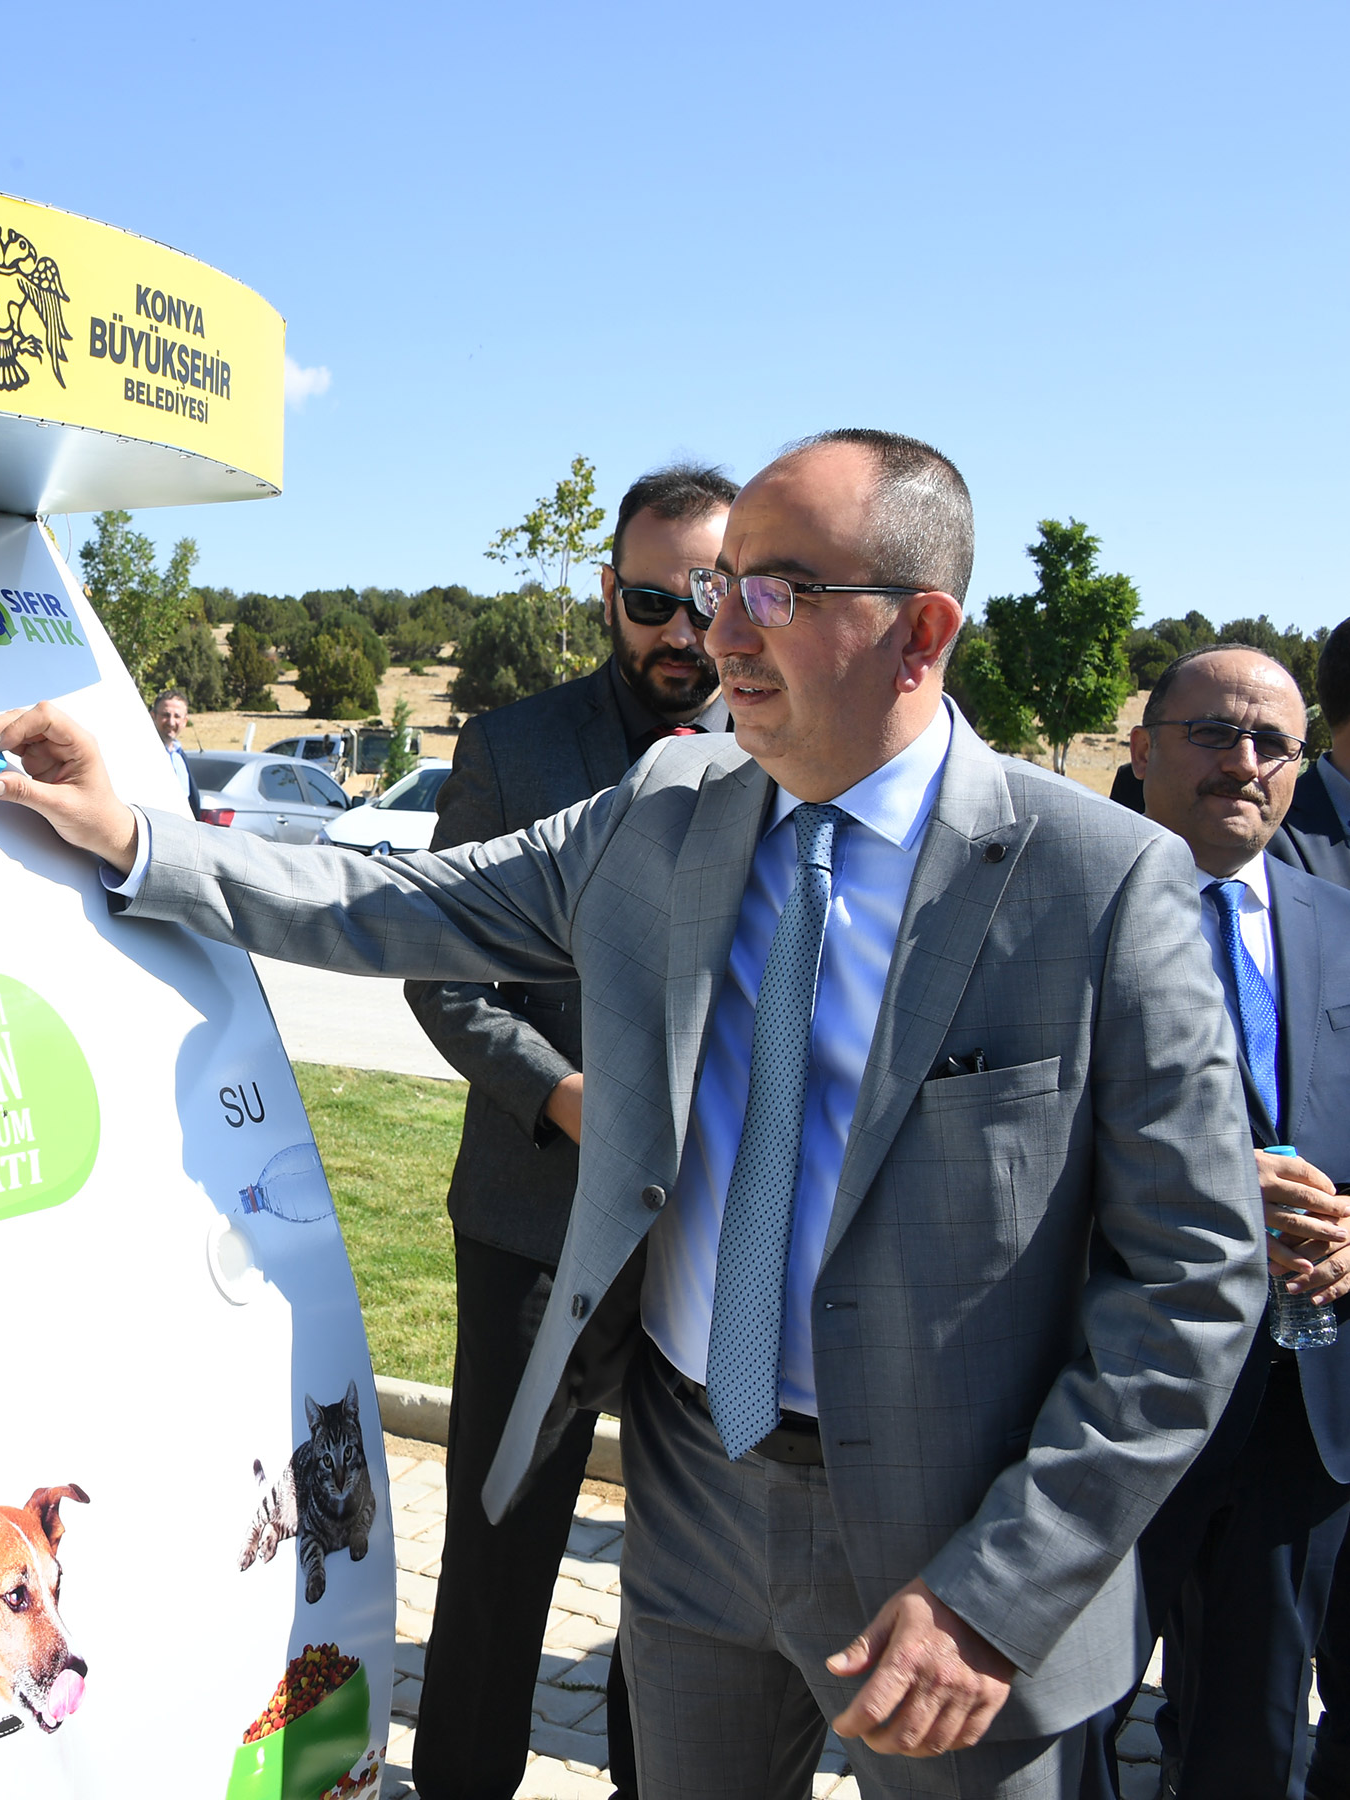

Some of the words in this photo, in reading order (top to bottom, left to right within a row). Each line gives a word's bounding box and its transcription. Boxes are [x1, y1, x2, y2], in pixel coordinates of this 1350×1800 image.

[136, 283, 206, 339] KONYA
[89, 313, 231, 400] BÜYÜKŞEHİR
[123, 377, 209, 424] BELEDİYESİ
[0, 588, 69, 618] SIFIR
[21, 615, 84, 646] ATIK
[219, 1080, 266, 1129] SU
